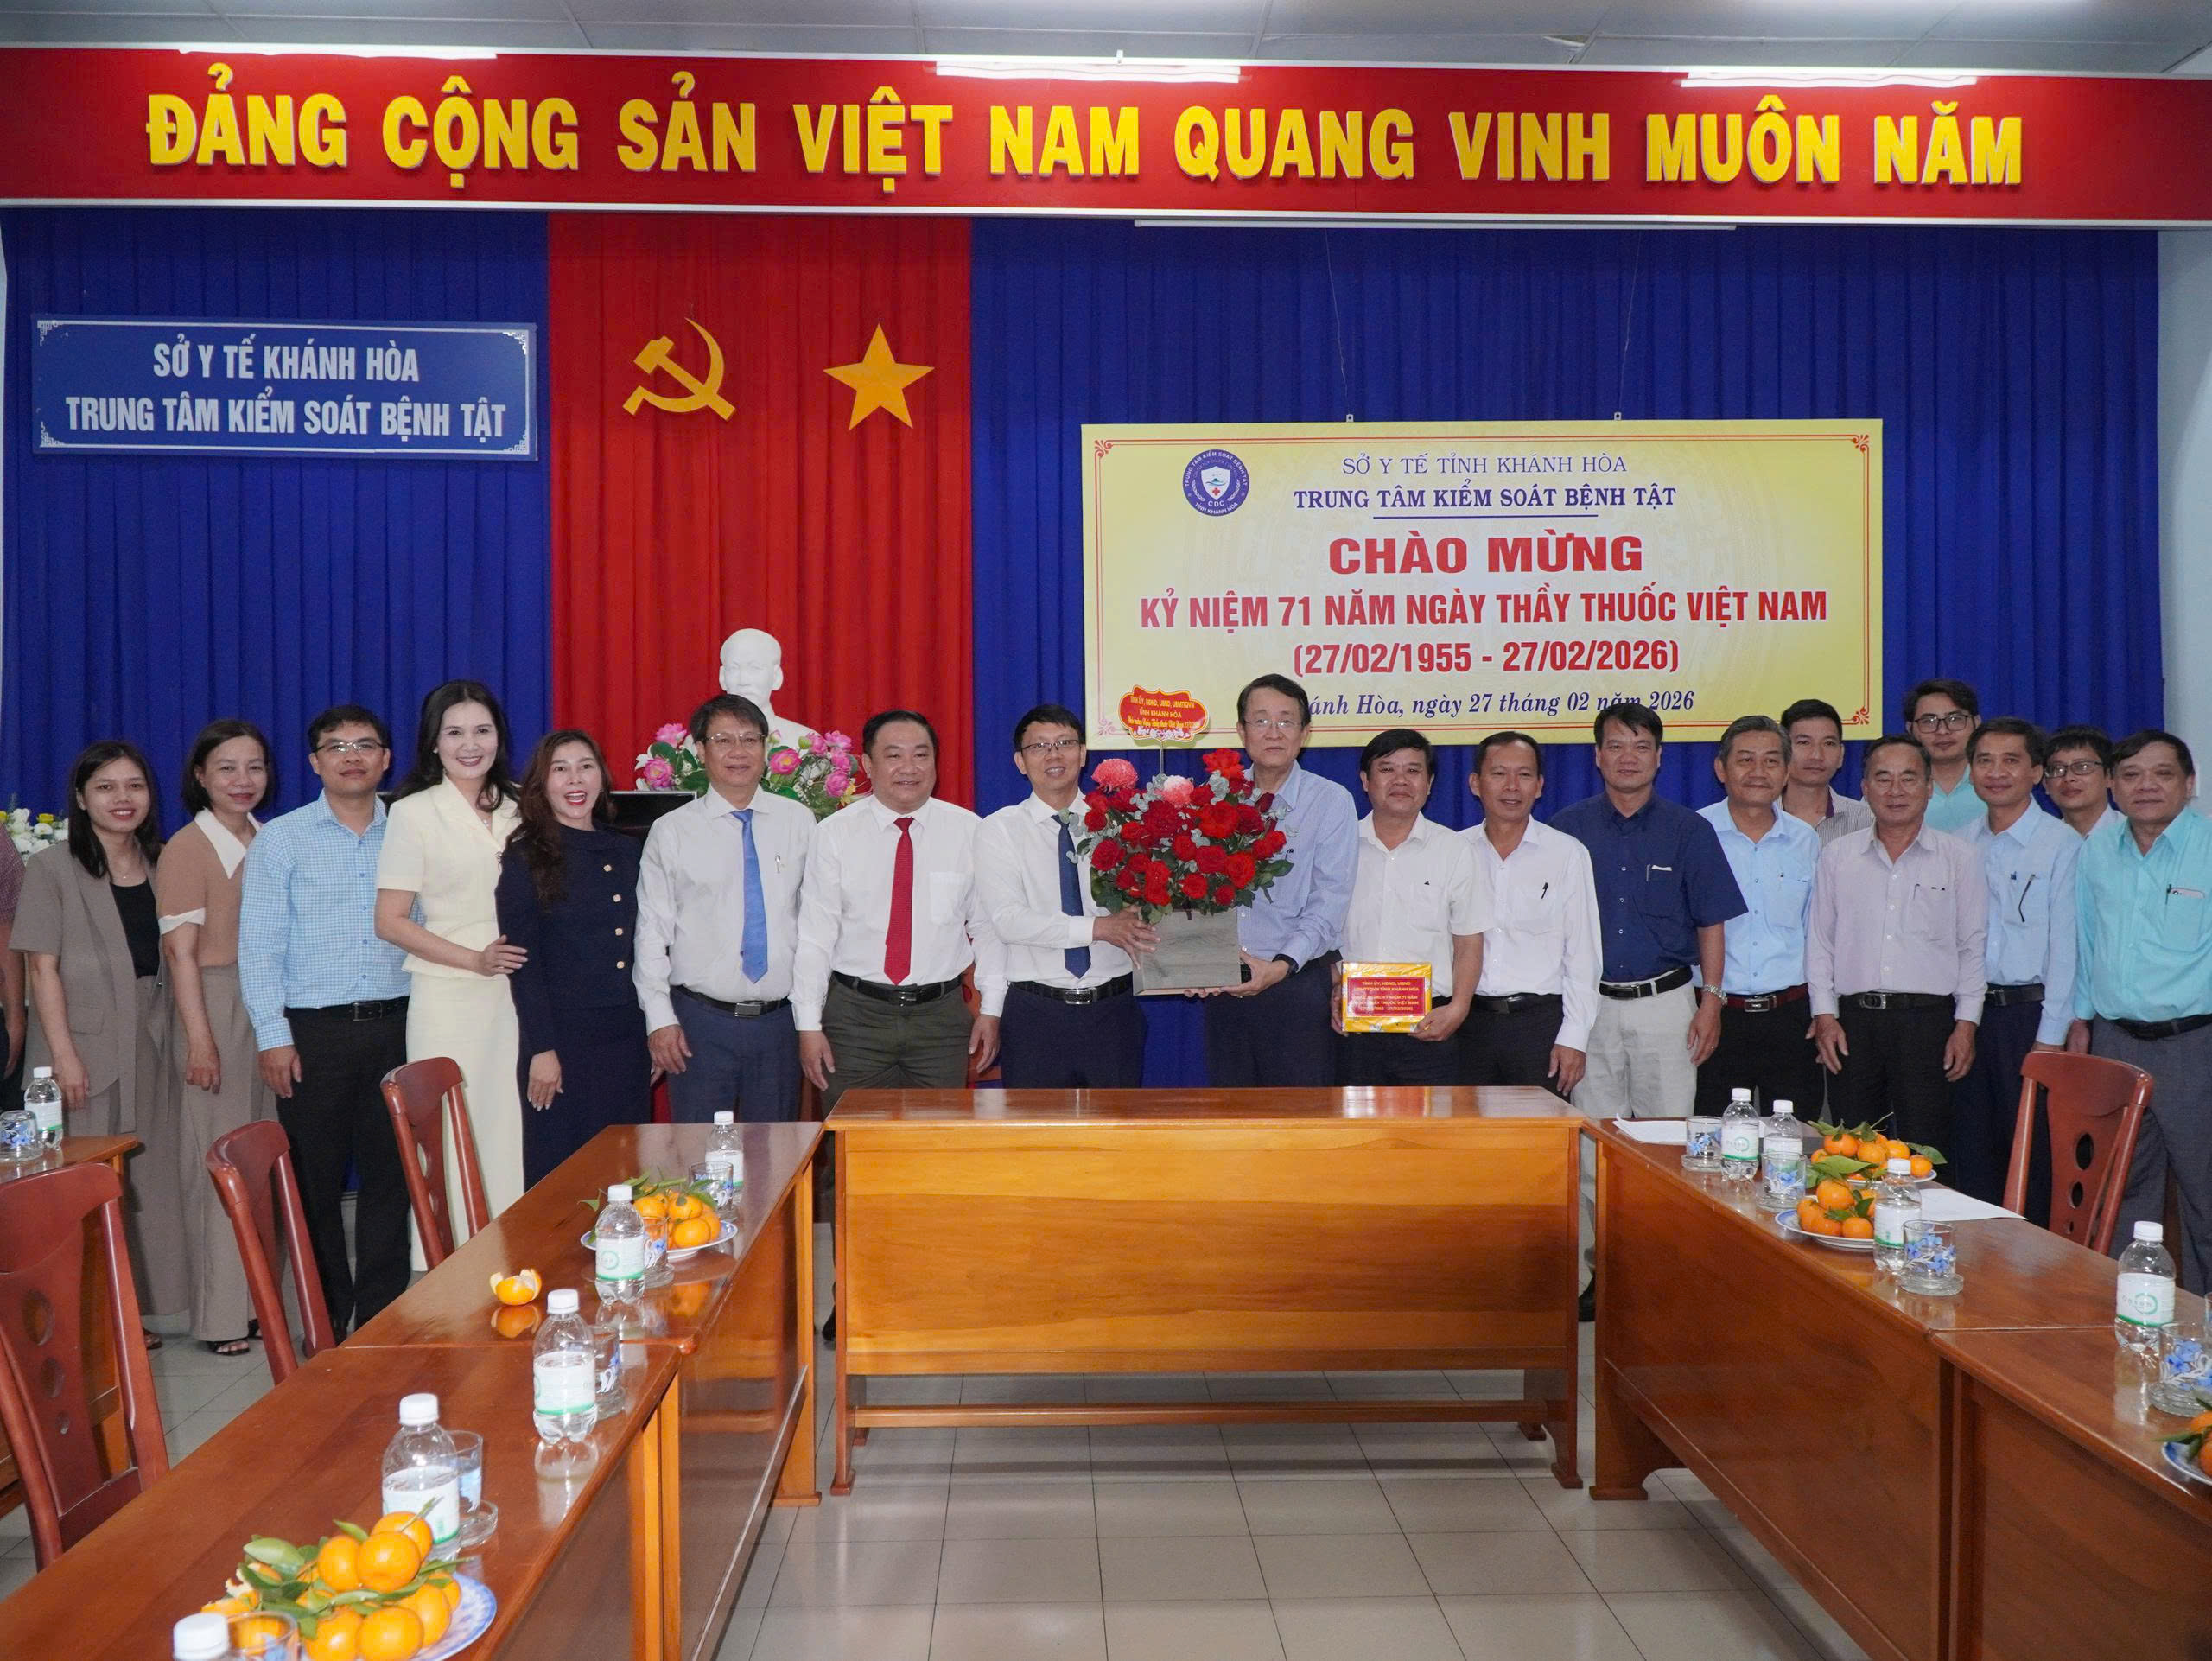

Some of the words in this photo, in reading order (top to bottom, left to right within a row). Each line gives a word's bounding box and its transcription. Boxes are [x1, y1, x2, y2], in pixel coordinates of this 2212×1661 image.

[145, 62, 348, 168] ĐẢNG
[382, 75, 579, 188] CỘNG
[617, 70, 757, 172] SẢN
[792, 86, 954, 193] VIỆT
[989, 105, 1140, 176] NAM
[1173, 105, 1414, 181] QUANG
[1448, 111, 1611, 181] VINH
[1645, 94, 1841, 184] MUÔN
[1873, 99, 2023, 185] NĂM
[153, 333, 190, 378] SỞ
[198, 344, 214, 378] Y
[223, 334, 256, 379] TẾ
[264, 338, 356, 380] KHÁNH
[366, 340, 420, 382] HÒA
[66, 396, 155, 431] TRUNG
[162, 391, 219, 433] TÂM
[228, 385, 295, 434] KIỂM
[304, 394, 372, 436] SOÁT
[381, 395, 450, 442] BỆNH
[461, 397, 506, 443] TẬT
[1342, 453, 1372, 475] SỞ
[1380, 456, 1395, 474] Y
[1400, 452, 1428, 474] TẾ
[1435, 452, 1487, 474] TỈNH
[1496, 455, 1573, 474] KHÁNH
[1581, 453, 1627, 474] HÒA
[1293, 489, 1370, 510] TRUNG
[1376, 485, 1426, 508] TÂM
[1433, 478, 1492, 508] KIỂM
[1499, 483, 1557, 507] SOÁT
[1564, 482, 1625, 510] BỆNH
[1632, 482, 1677, 511] TẬT
[1329, 528, 1468, 576] CHÀO
[1487, 525, 1643, 573] MỪNG
[1141, 587, 1179, 628] KỶ
[1189, 590, 1268, 633] NIỆM
[1278, 595, 1311, 627] 71
[1325, 589, 1395, 627] NĂM
[1406, 587, 1486, 625] NGÀY
[1496, 582, 1571, 624] THẦY
[1580, 581, 1677, 623] THUỐC
[1686, 585, 1750, 628] VIỆT
[1759, 590, 1828, 622] NAM
[1294, 642, 1472, 678] (27/02/1955
[1503, 639, 1680, 674] 27/02/2026)
[1308, 695, 1349, 715] ánh
[1356, 694, 1404, 718] Hòa,
[1412, 694, 1462, 718] ngày
[1469, 693, 1493, 713] 27
[1499, 692, 1560, 716] tháng
[1567, 692, 1590, 711] 02
[1650, 691, 1694, 710] 2026
